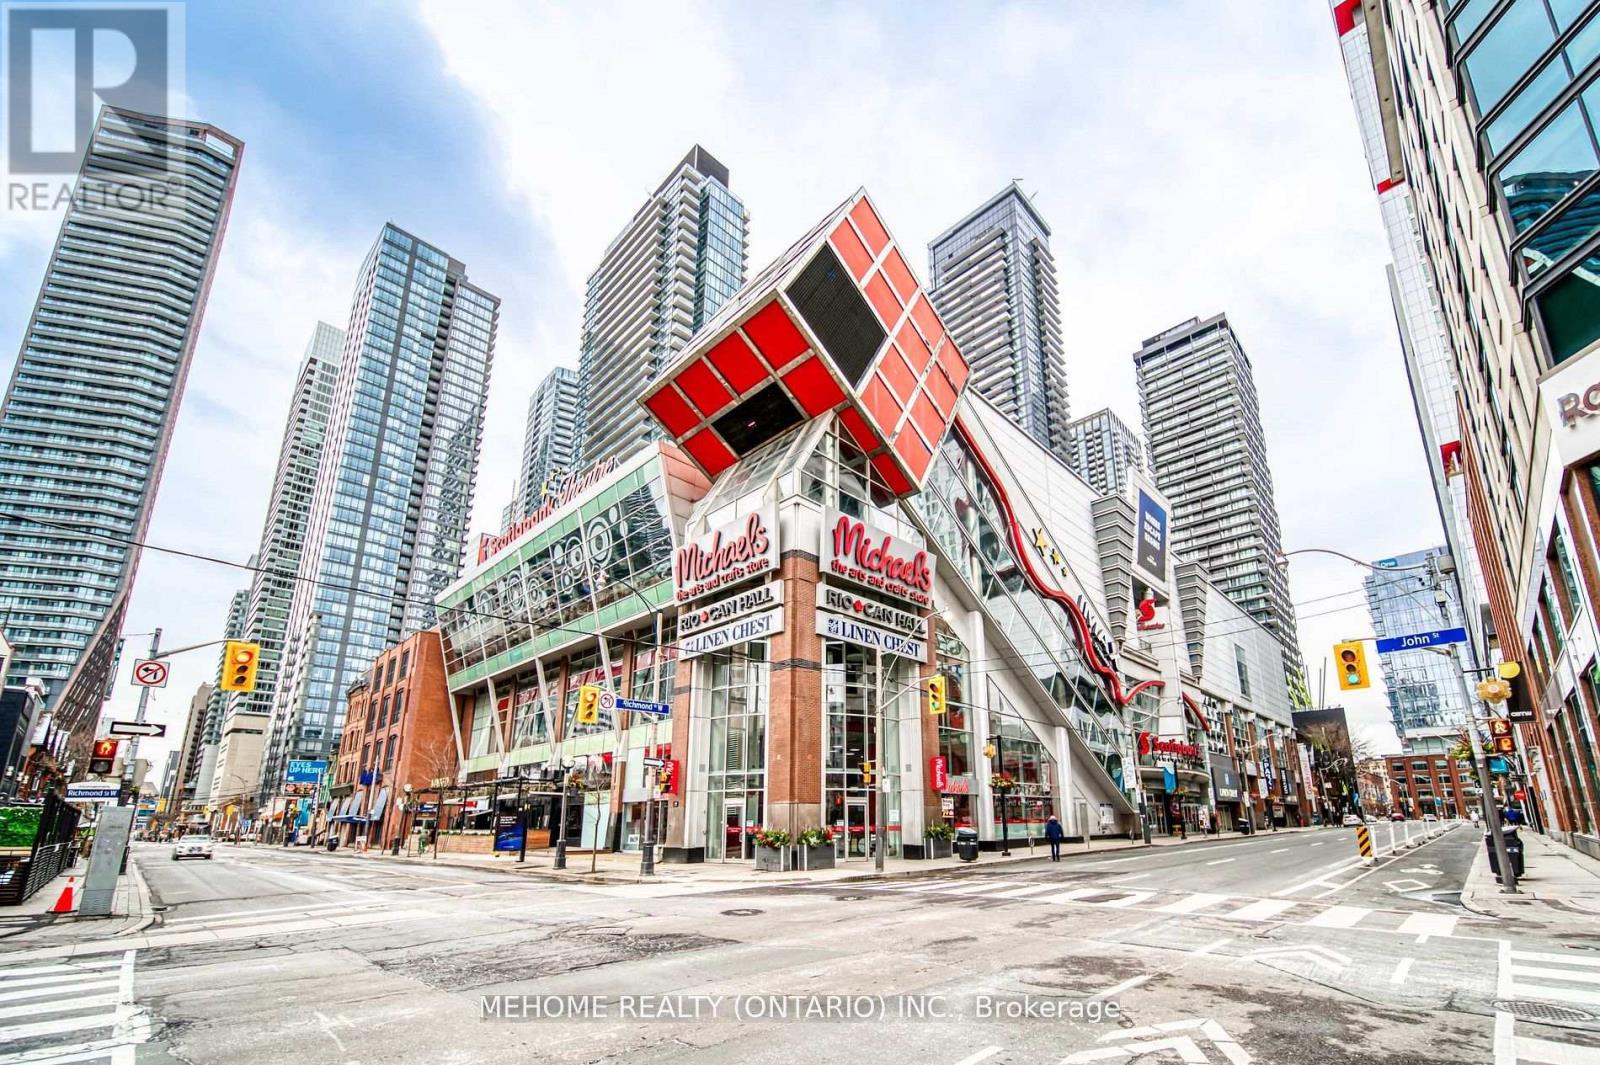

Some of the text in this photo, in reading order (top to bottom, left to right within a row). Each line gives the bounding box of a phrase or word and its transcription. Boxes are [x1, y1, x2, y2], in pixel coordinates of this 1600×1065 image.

[675, 512, 769, 587] Michaels
[832, 516, 931, 592] Michaels
[704, 574, 720, 590] and
[831, 559, 848, 574] the
[848, 567, 866, 582] arts
[867, 574, 885, 589] and
[885, 582, 908, 597] crafts
[739, 587, 775, 611] HALL
[695, 614, 773, 652] LINEN CHEST
[841, 620, 881, 646] LINEN
[895, 612, 927, 635] HALL
[1401, 635, 1431, 648] John
[623, 699, 652, 711] Richmond
[68, 789, 103, 797] Richmond
